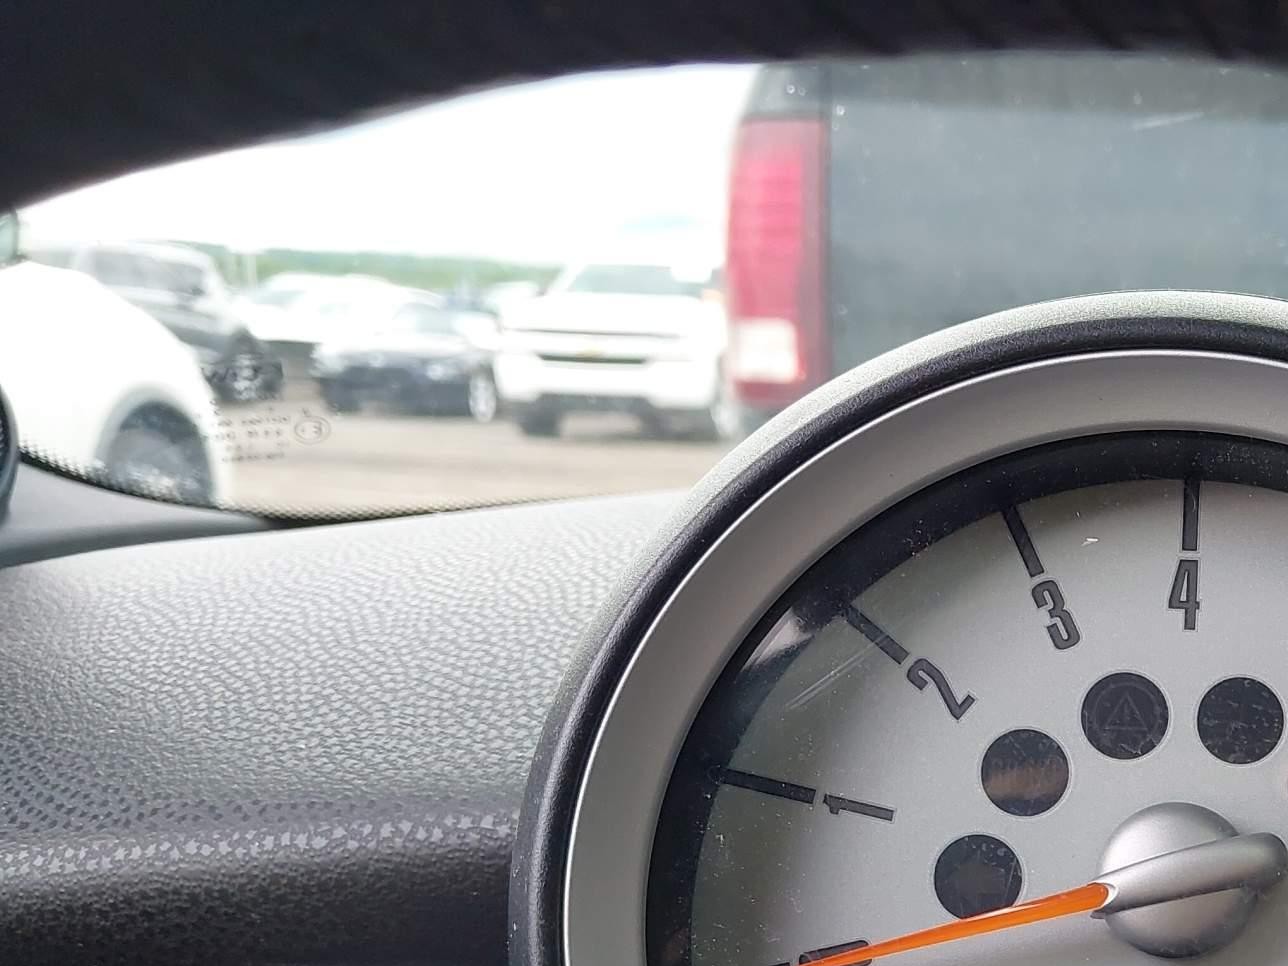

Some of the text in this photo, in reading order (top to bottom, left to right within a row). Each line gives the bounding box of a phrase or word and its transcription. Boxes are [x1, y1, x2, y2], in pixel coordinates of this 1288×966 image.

[1031, 579, 1081, 650] 3
[1168, 559, 1200, 630] 4
[906, 657, 977, 720] 2
[823, 793, 895, 821] 1
